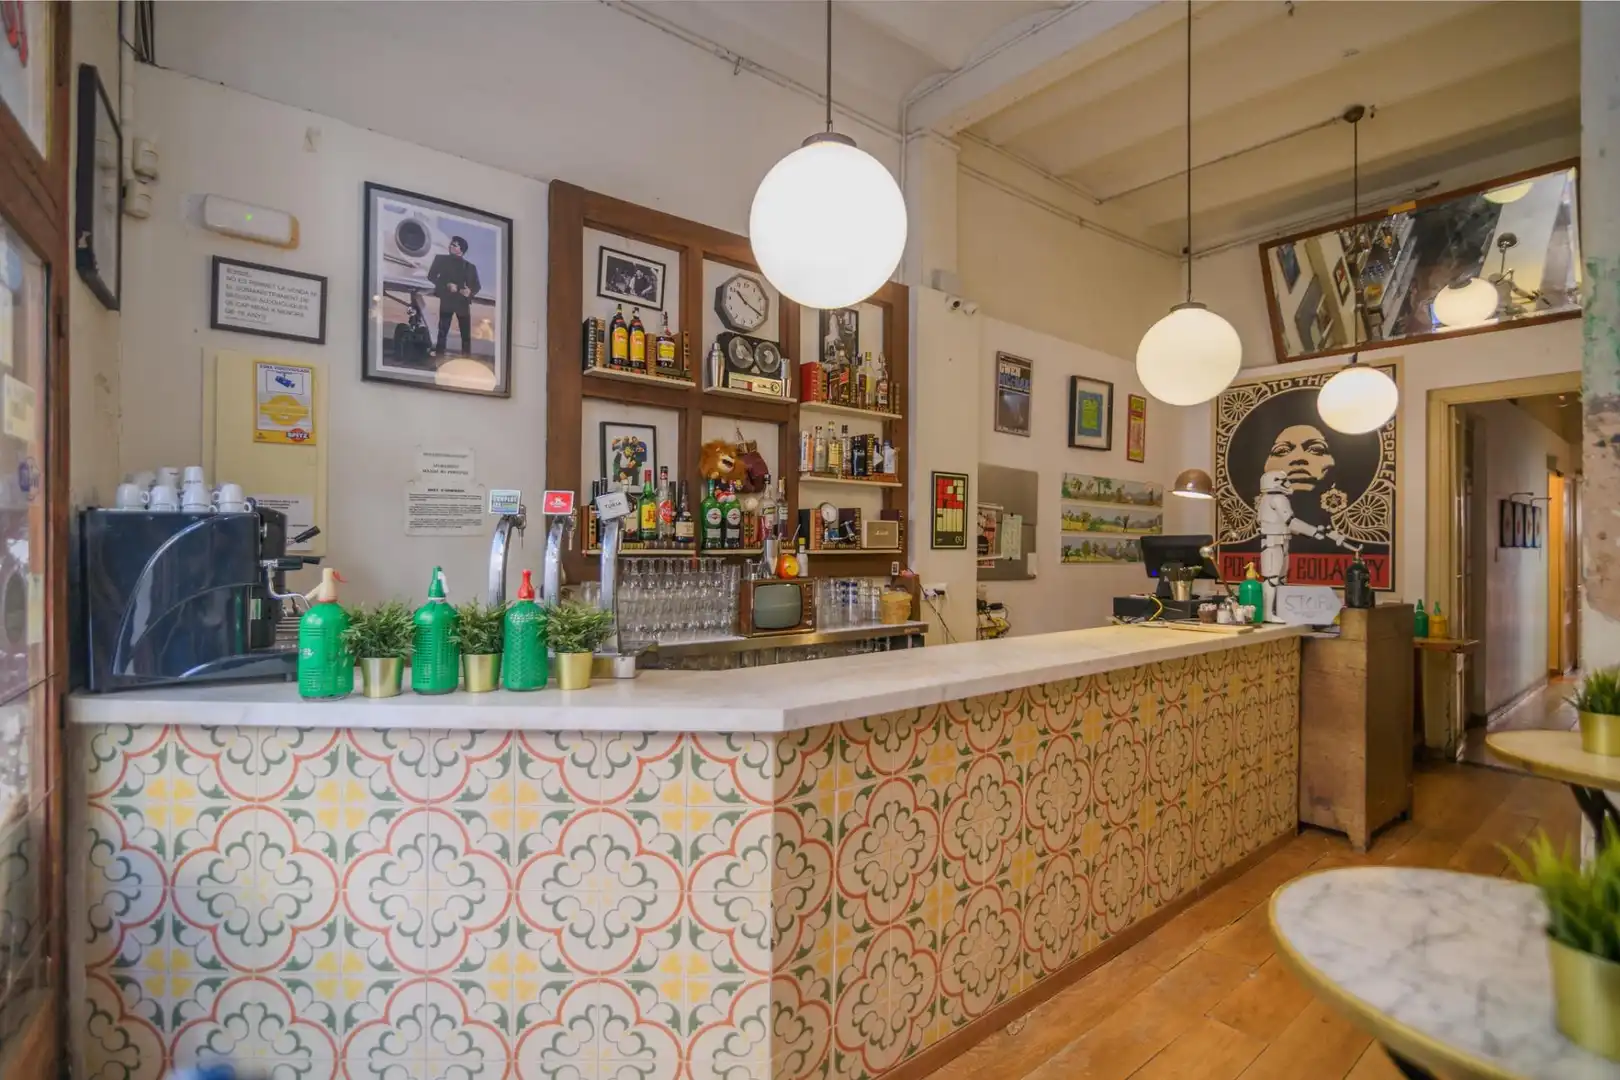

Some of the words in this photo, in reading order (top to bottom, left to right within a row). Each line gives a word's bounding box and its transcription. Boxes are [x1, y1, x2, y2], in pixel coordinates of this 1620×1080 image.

[1268, 379, 1291, 393] TO
[1295, 373, 1329, 387] THE
[1216, 435, 1229, 488] POWER
[1379, 419, 1395, 482] PEOPLE
